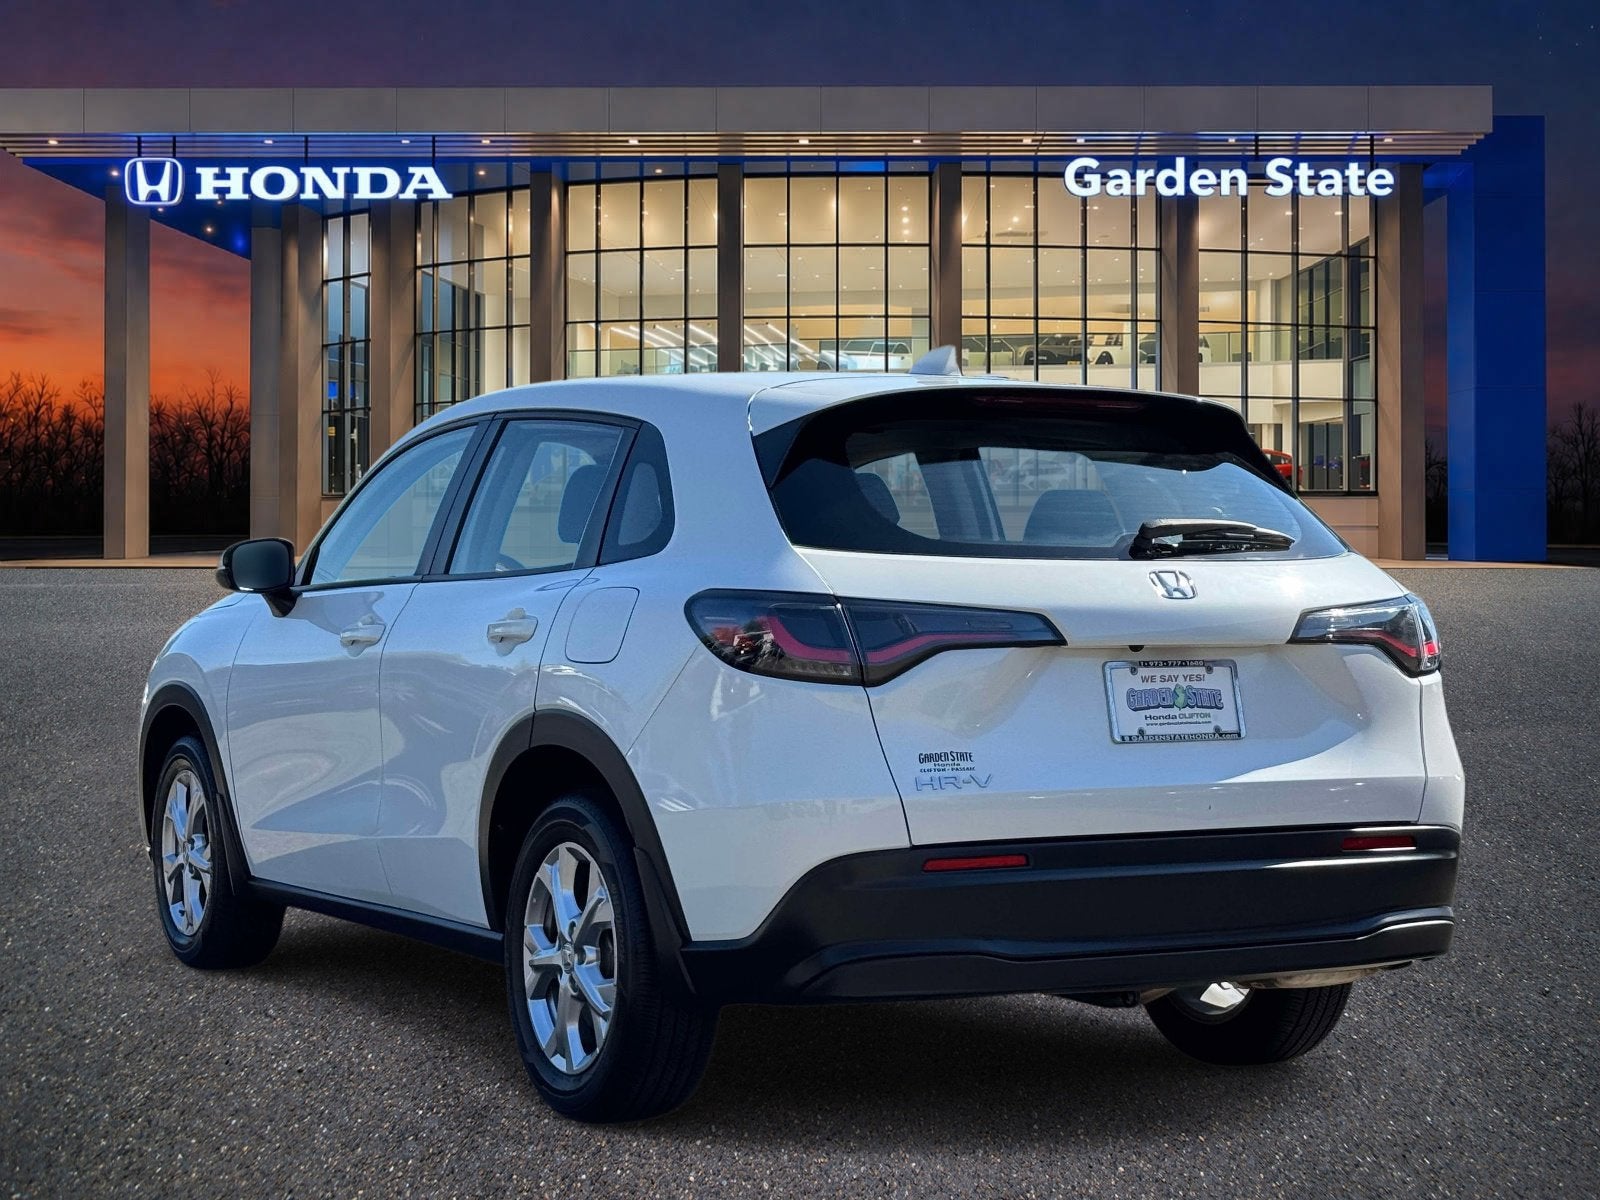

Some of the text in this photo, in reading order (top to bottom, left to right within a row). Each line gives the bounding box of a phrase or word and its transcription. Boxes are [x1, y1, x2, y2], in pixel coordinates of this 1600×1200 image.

[195, 165, 453, 201] HONDA
[1063, 156, 1395, 197] Garden State
[1141, 674, 1205, 683] WE SAY YES!
[1126, 685, 1224, 711] GARDEN STATE
[1144, 712, 1211, 721] Honda CLIFTON
[919, 750, 974, 764] GARDEN STATE
[915, 773, 992, 791] HR-V
